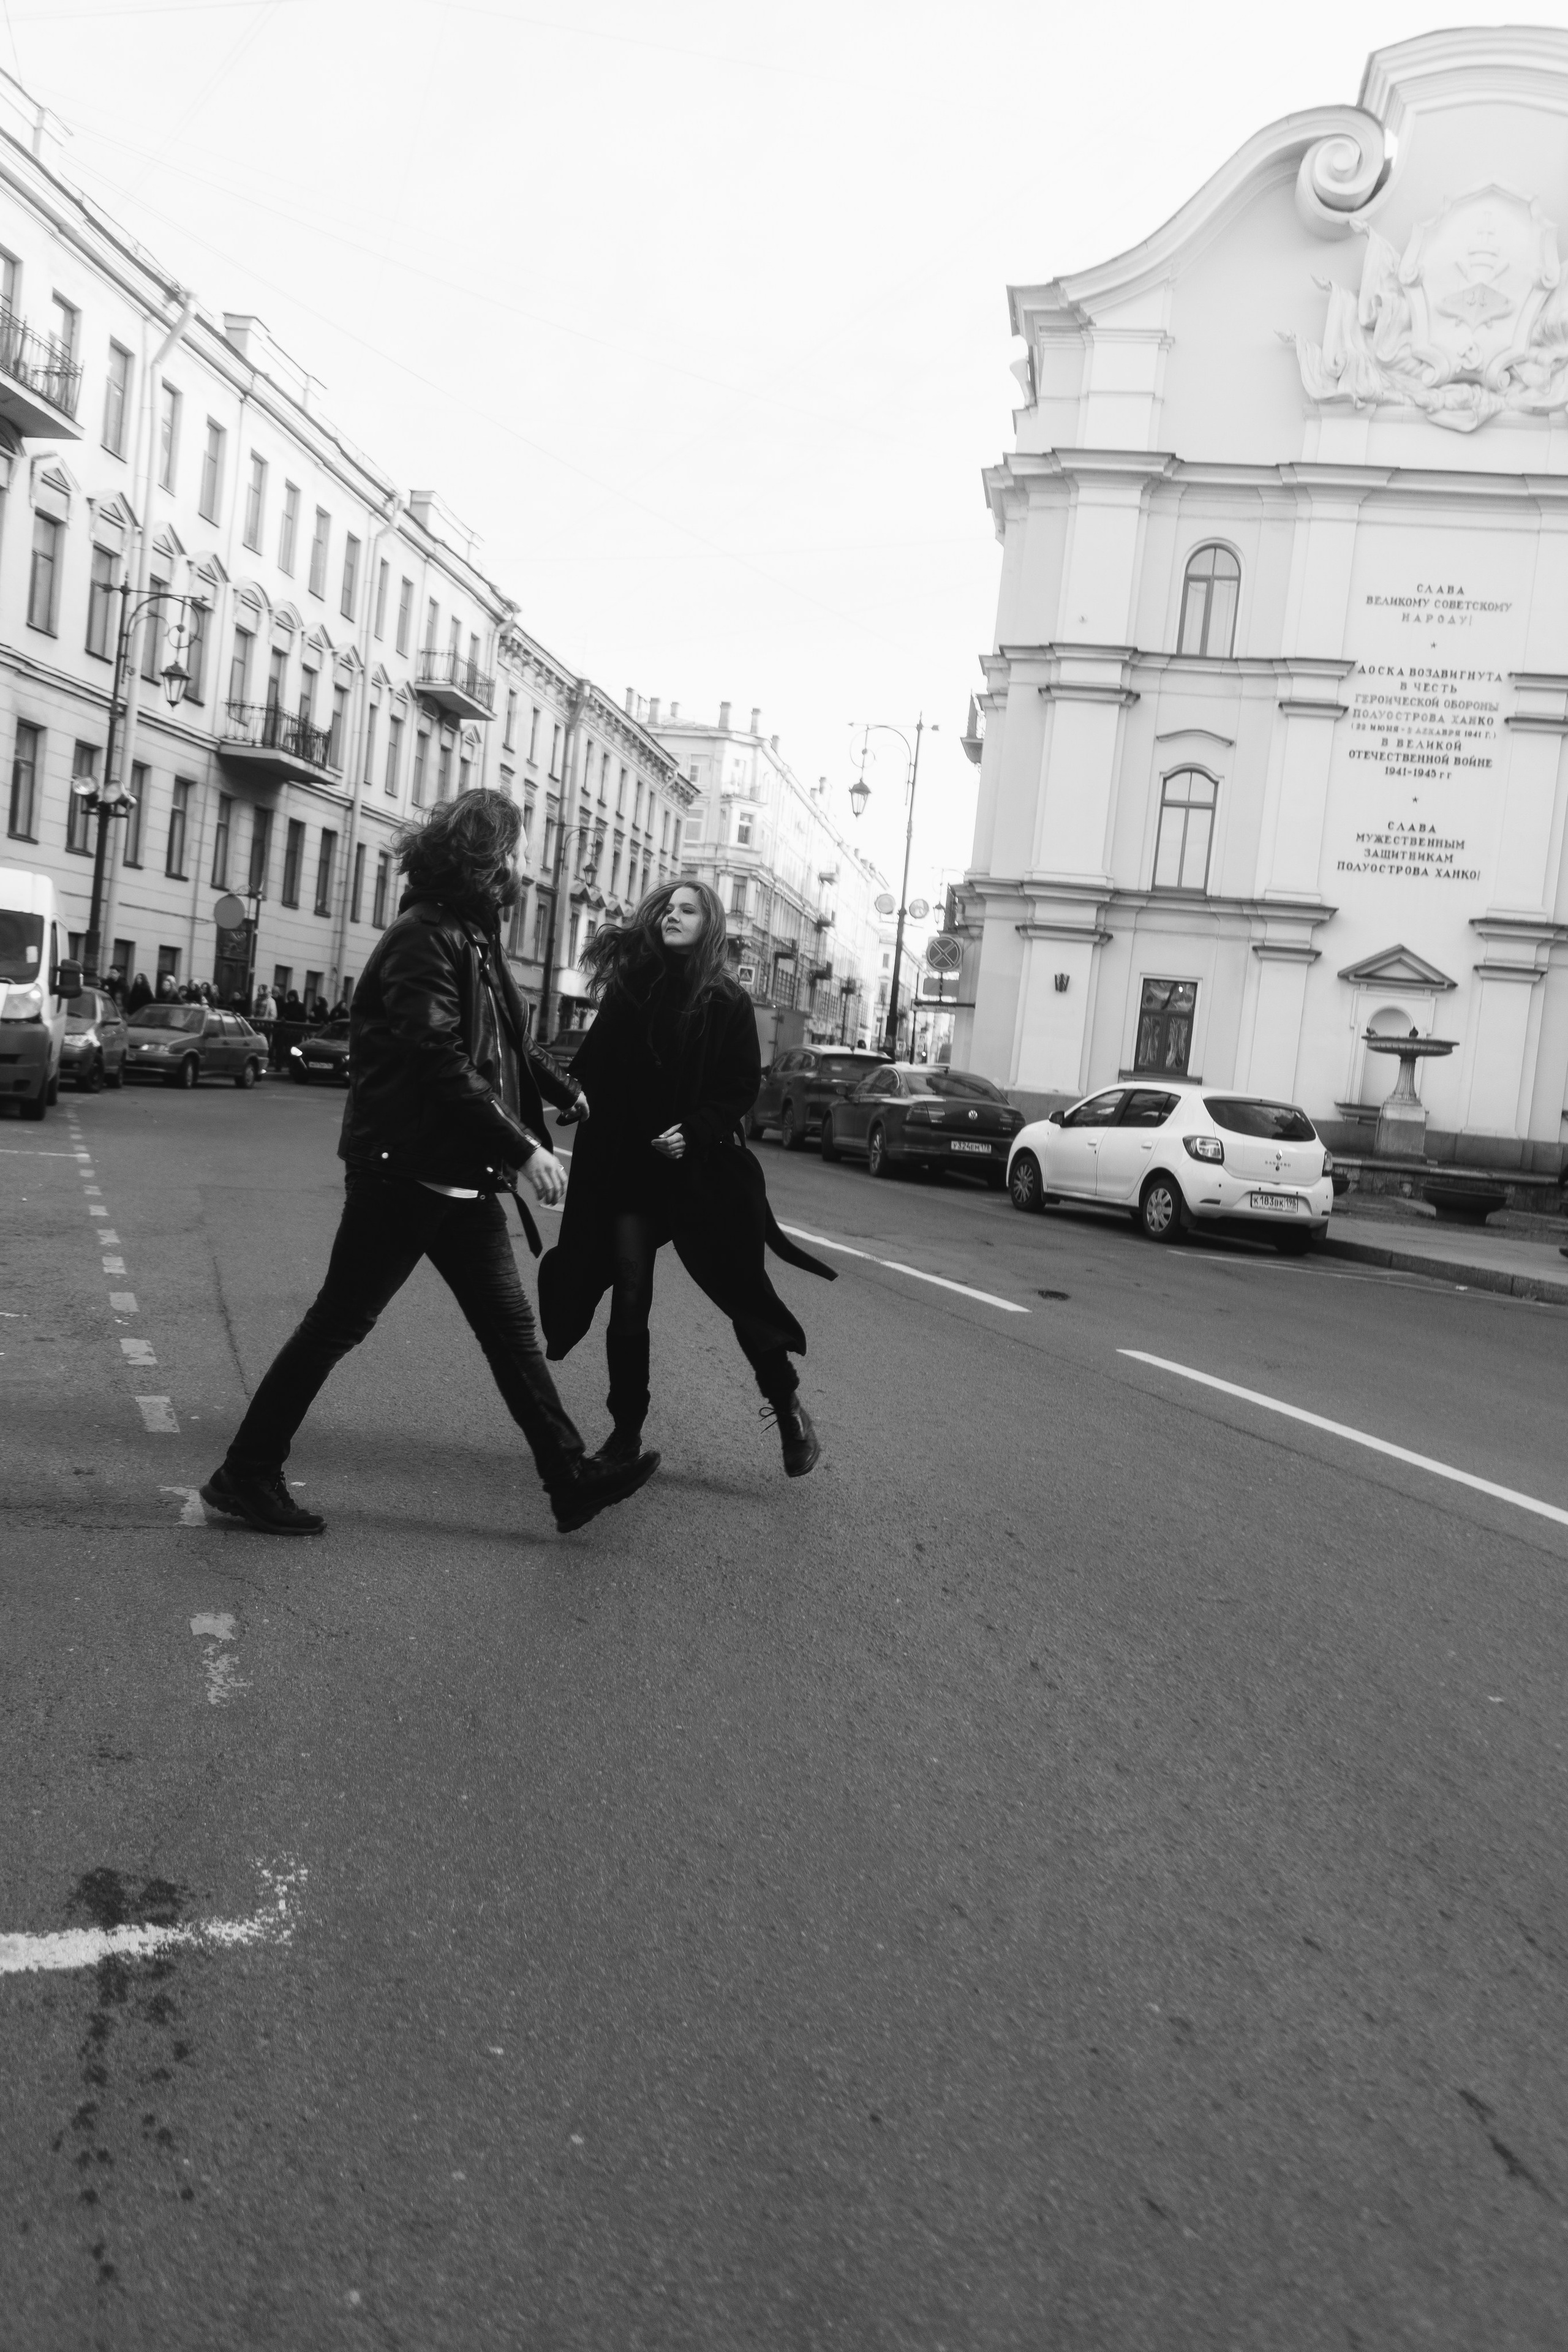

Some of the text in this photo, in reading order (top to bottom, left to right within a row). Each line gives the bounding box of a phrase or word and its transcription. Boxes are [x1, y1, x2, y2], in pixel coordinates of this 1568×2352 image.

[1417, 584, 1464, 595] СЛАВА
[1366, 595, 1512, 612] ВЕЛИКОМУ СОВЕТСКОМУ
[1401, 612, 1473, 626] НАРОДУ!
[1358, 665, 1503, 682] ДОСКА ВОЗДВИГНУТА
[1400, 682, 1457, 693] В ЧЕСТЬ
[1355, 693, 1499, 712] ГЕРОИЧЕСКОЙ ОБОРОНЫ
[1352, 708, 1494, 726] ПОЛУОСТРОВА ХАНКО
[1370, 723, 1398, 733] ИЮНЯ
[1415, 727, 1460, 736] ДЕКАБРЯ
[1381, 737, 1462, 752] В ВЕЛИКОЙ
[1349, 750, 1493, 768] ОТЕЧЕСТВЕННОЙ ВОЙНЕ
[1385, 766, 1436, 778] 1941-1945
[1388, 821, 1436, 833] СЛАВА
[1356, 832, 1465, 850] МУЖЕСТВЕННЫМ
[1364, 848, 1453, 863] ЗАЩИТНИКАМ
[1337, 861, 1480, 881] ПОЛУОСТРОВА ХАНКО!
